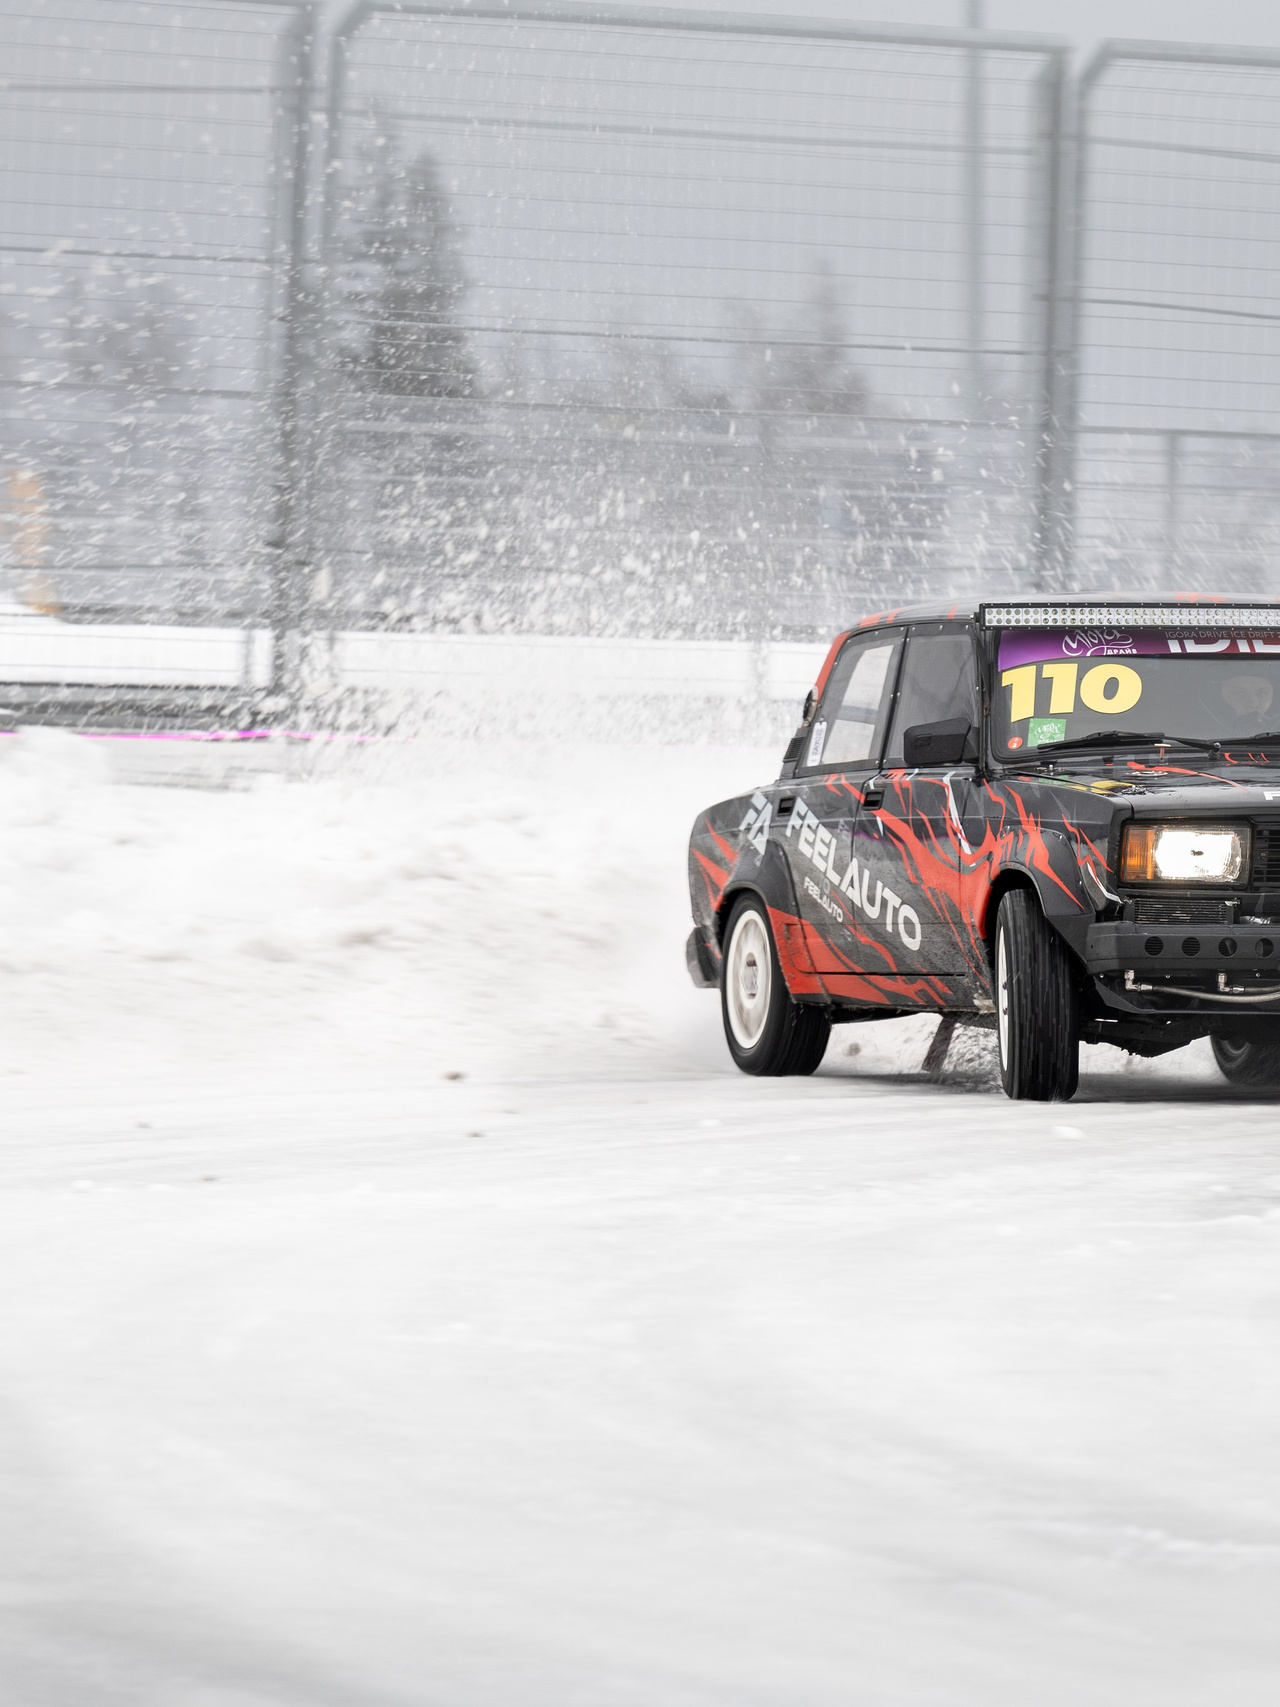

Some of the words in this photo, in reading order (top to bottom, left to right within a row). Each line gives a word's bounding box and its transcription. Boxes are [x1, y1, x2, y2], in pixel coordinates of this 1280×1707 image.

[1107, 647, 1138, 655] ДРАЙВ
[1165, 631, 1198, 639] IGORA
[1001, 663, 1142, 723] 110
[785, 797, 922, 951] FEELAUTO
